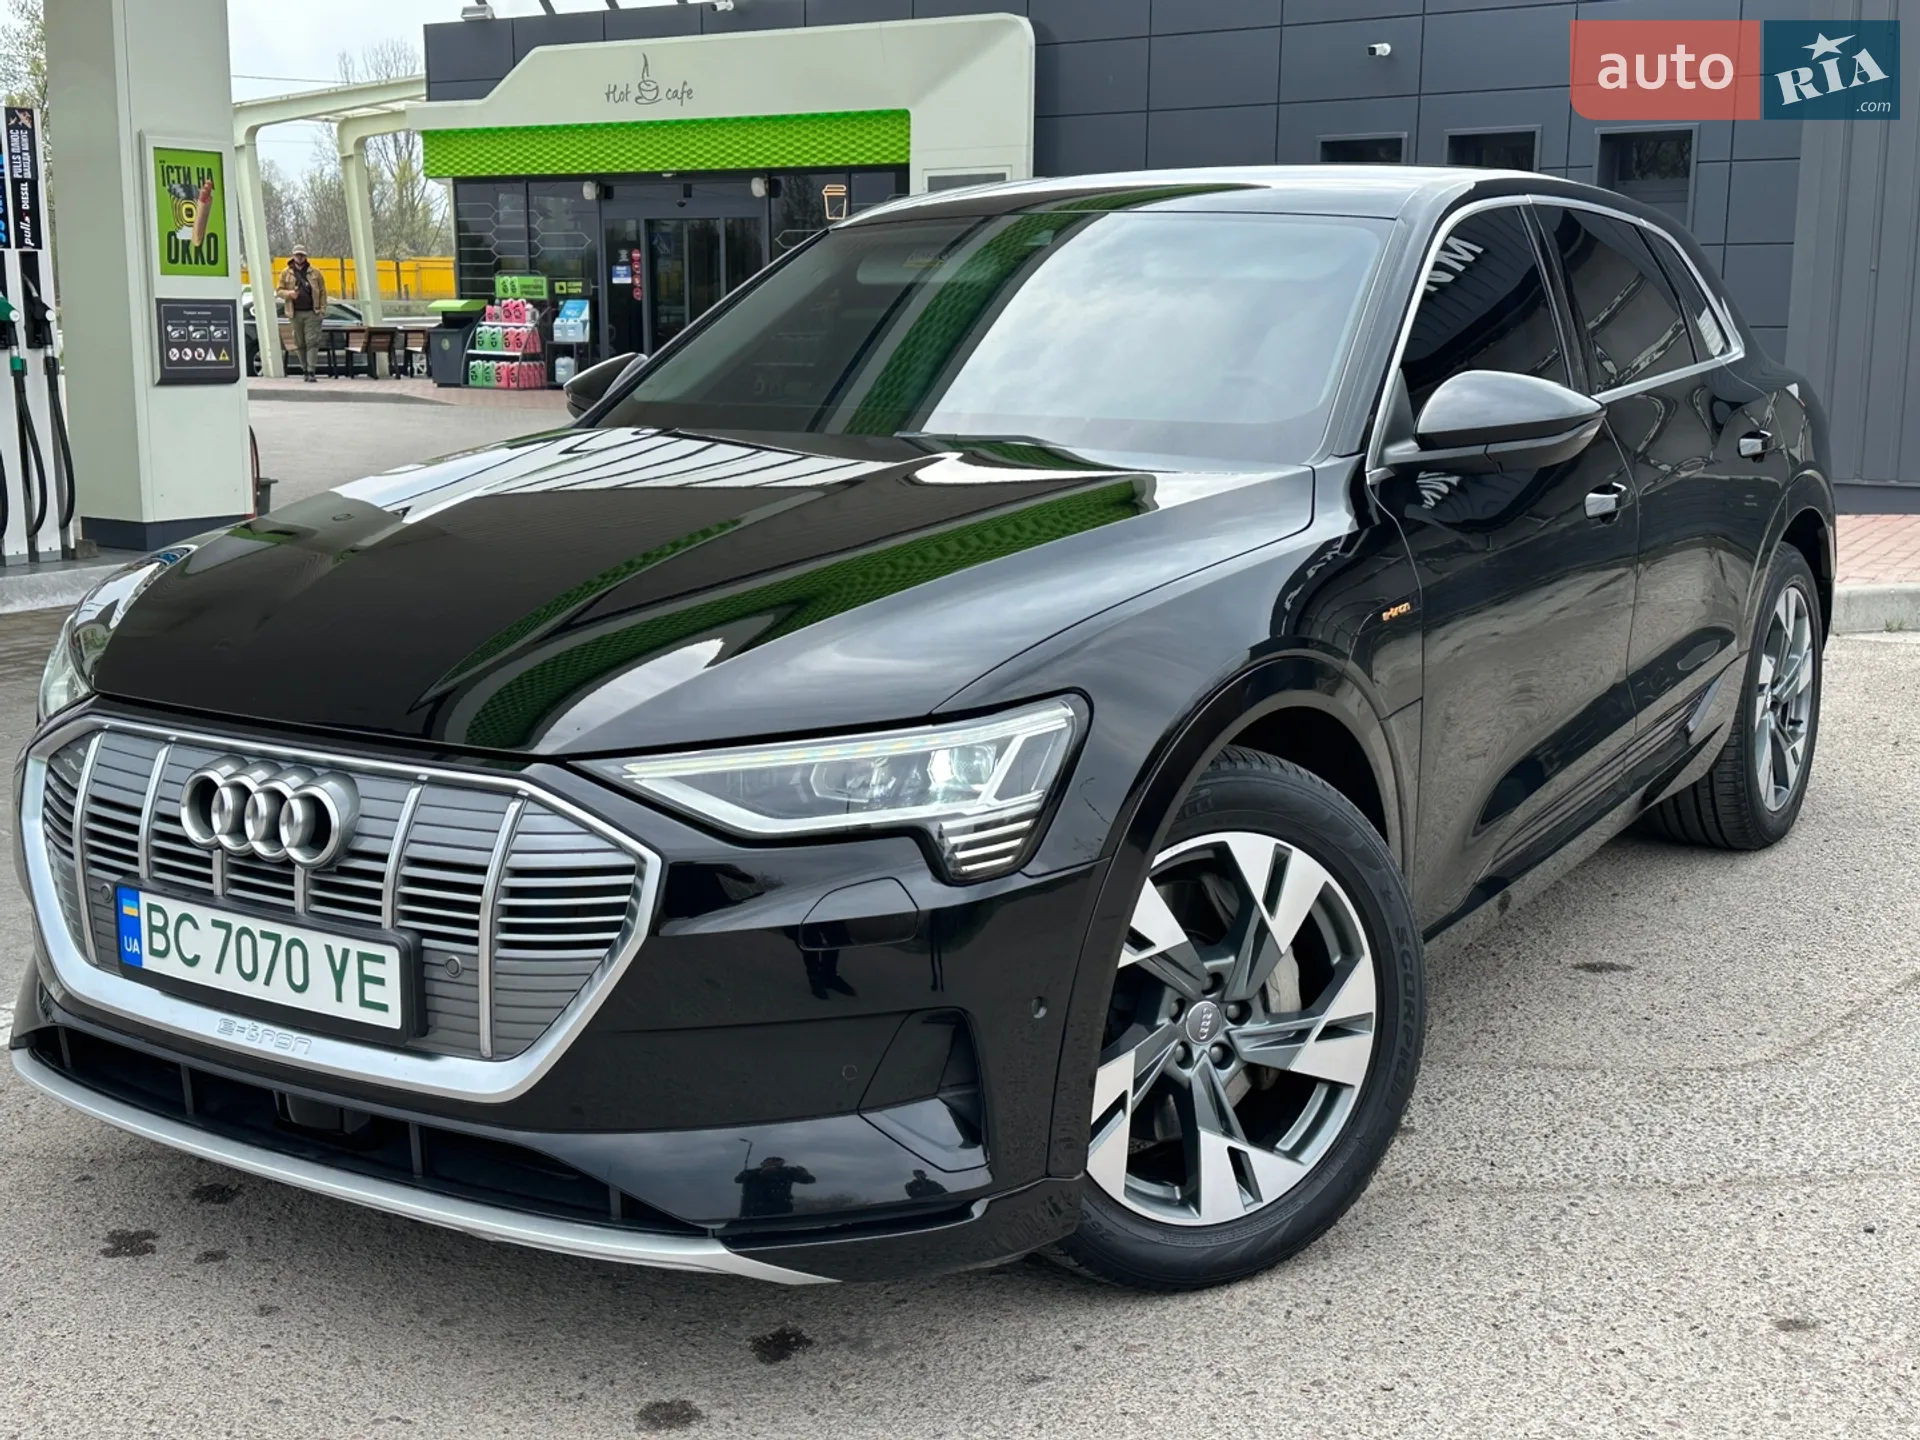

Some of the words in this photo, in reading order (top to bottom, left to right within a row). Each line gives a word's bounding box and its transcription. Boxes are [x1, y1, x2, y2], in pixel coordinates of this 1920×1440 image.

[604, 83, 631, 104] Hot
[665, 80, 694, 107] cafe
[159, 160, 192, 188] ЇСТИ
[21, 181, 30, 210] DIESEL
[124, 935, 141, 955] UA
[146, 901, 201, 968] BC
[211, 918, 310, 994] 7070
[324, 943, 390, 1013] YE
[216, 1017, 313, 1056] e-tron
